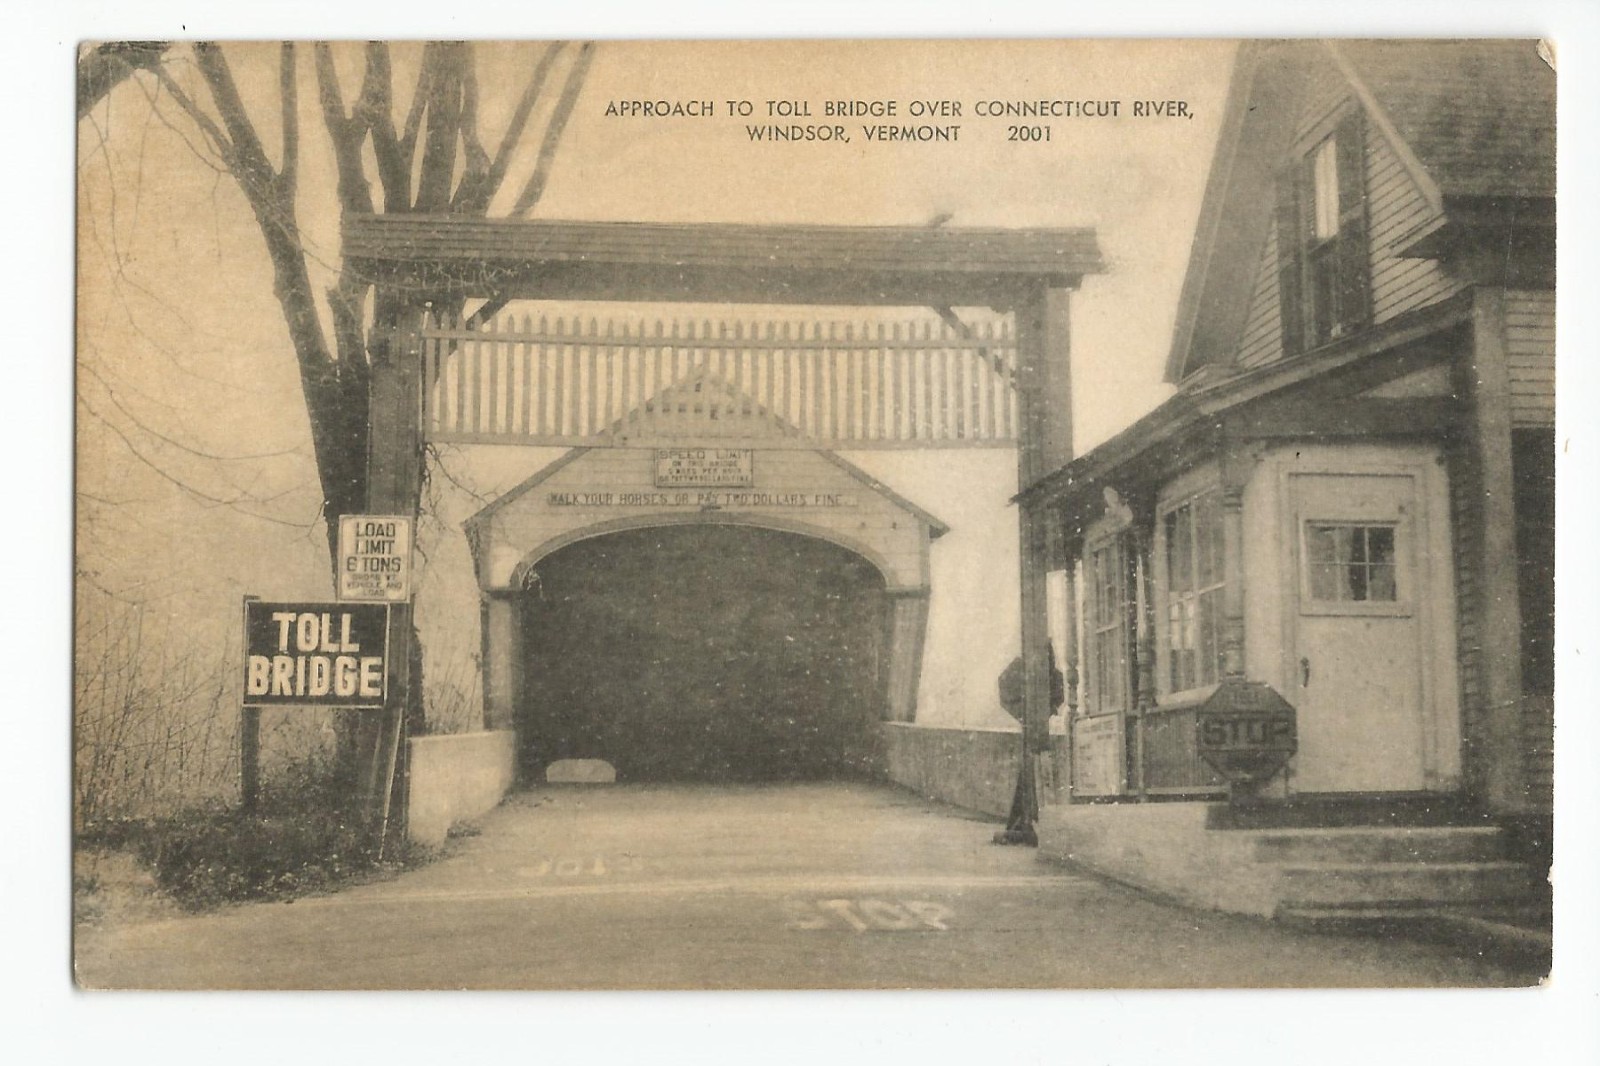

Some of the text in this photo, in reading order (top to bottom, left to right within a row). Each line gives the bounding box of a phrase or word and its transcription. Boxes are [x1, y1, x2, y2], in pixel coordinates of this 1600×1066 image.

[659, 449, 750, 460] SPEED LIMIT
[549, 493, 579, 506] WALK
[584, 493, 614, 506] YOUR
[619, 493, 668, 506] HORSES
[675, 493, 689, 506] OR
[697, 492, 720, 506] PAY
[725, 493, 748, 506] TWO
[753, 493, 807, 507] DOLLARS
[355, 521, 396, 538] LOAD
[355, 539, 395, 555] LIMIT
[362, 556, 402, 573] TONS
[363, 589, 385, 597] LOAD
[272, 612, 360, 653] TOLL
[247, 655, 383, 697] BRIDGE
[1202, 718, 1290, 745] STOP
[784, 898, 955, 932] STOP
